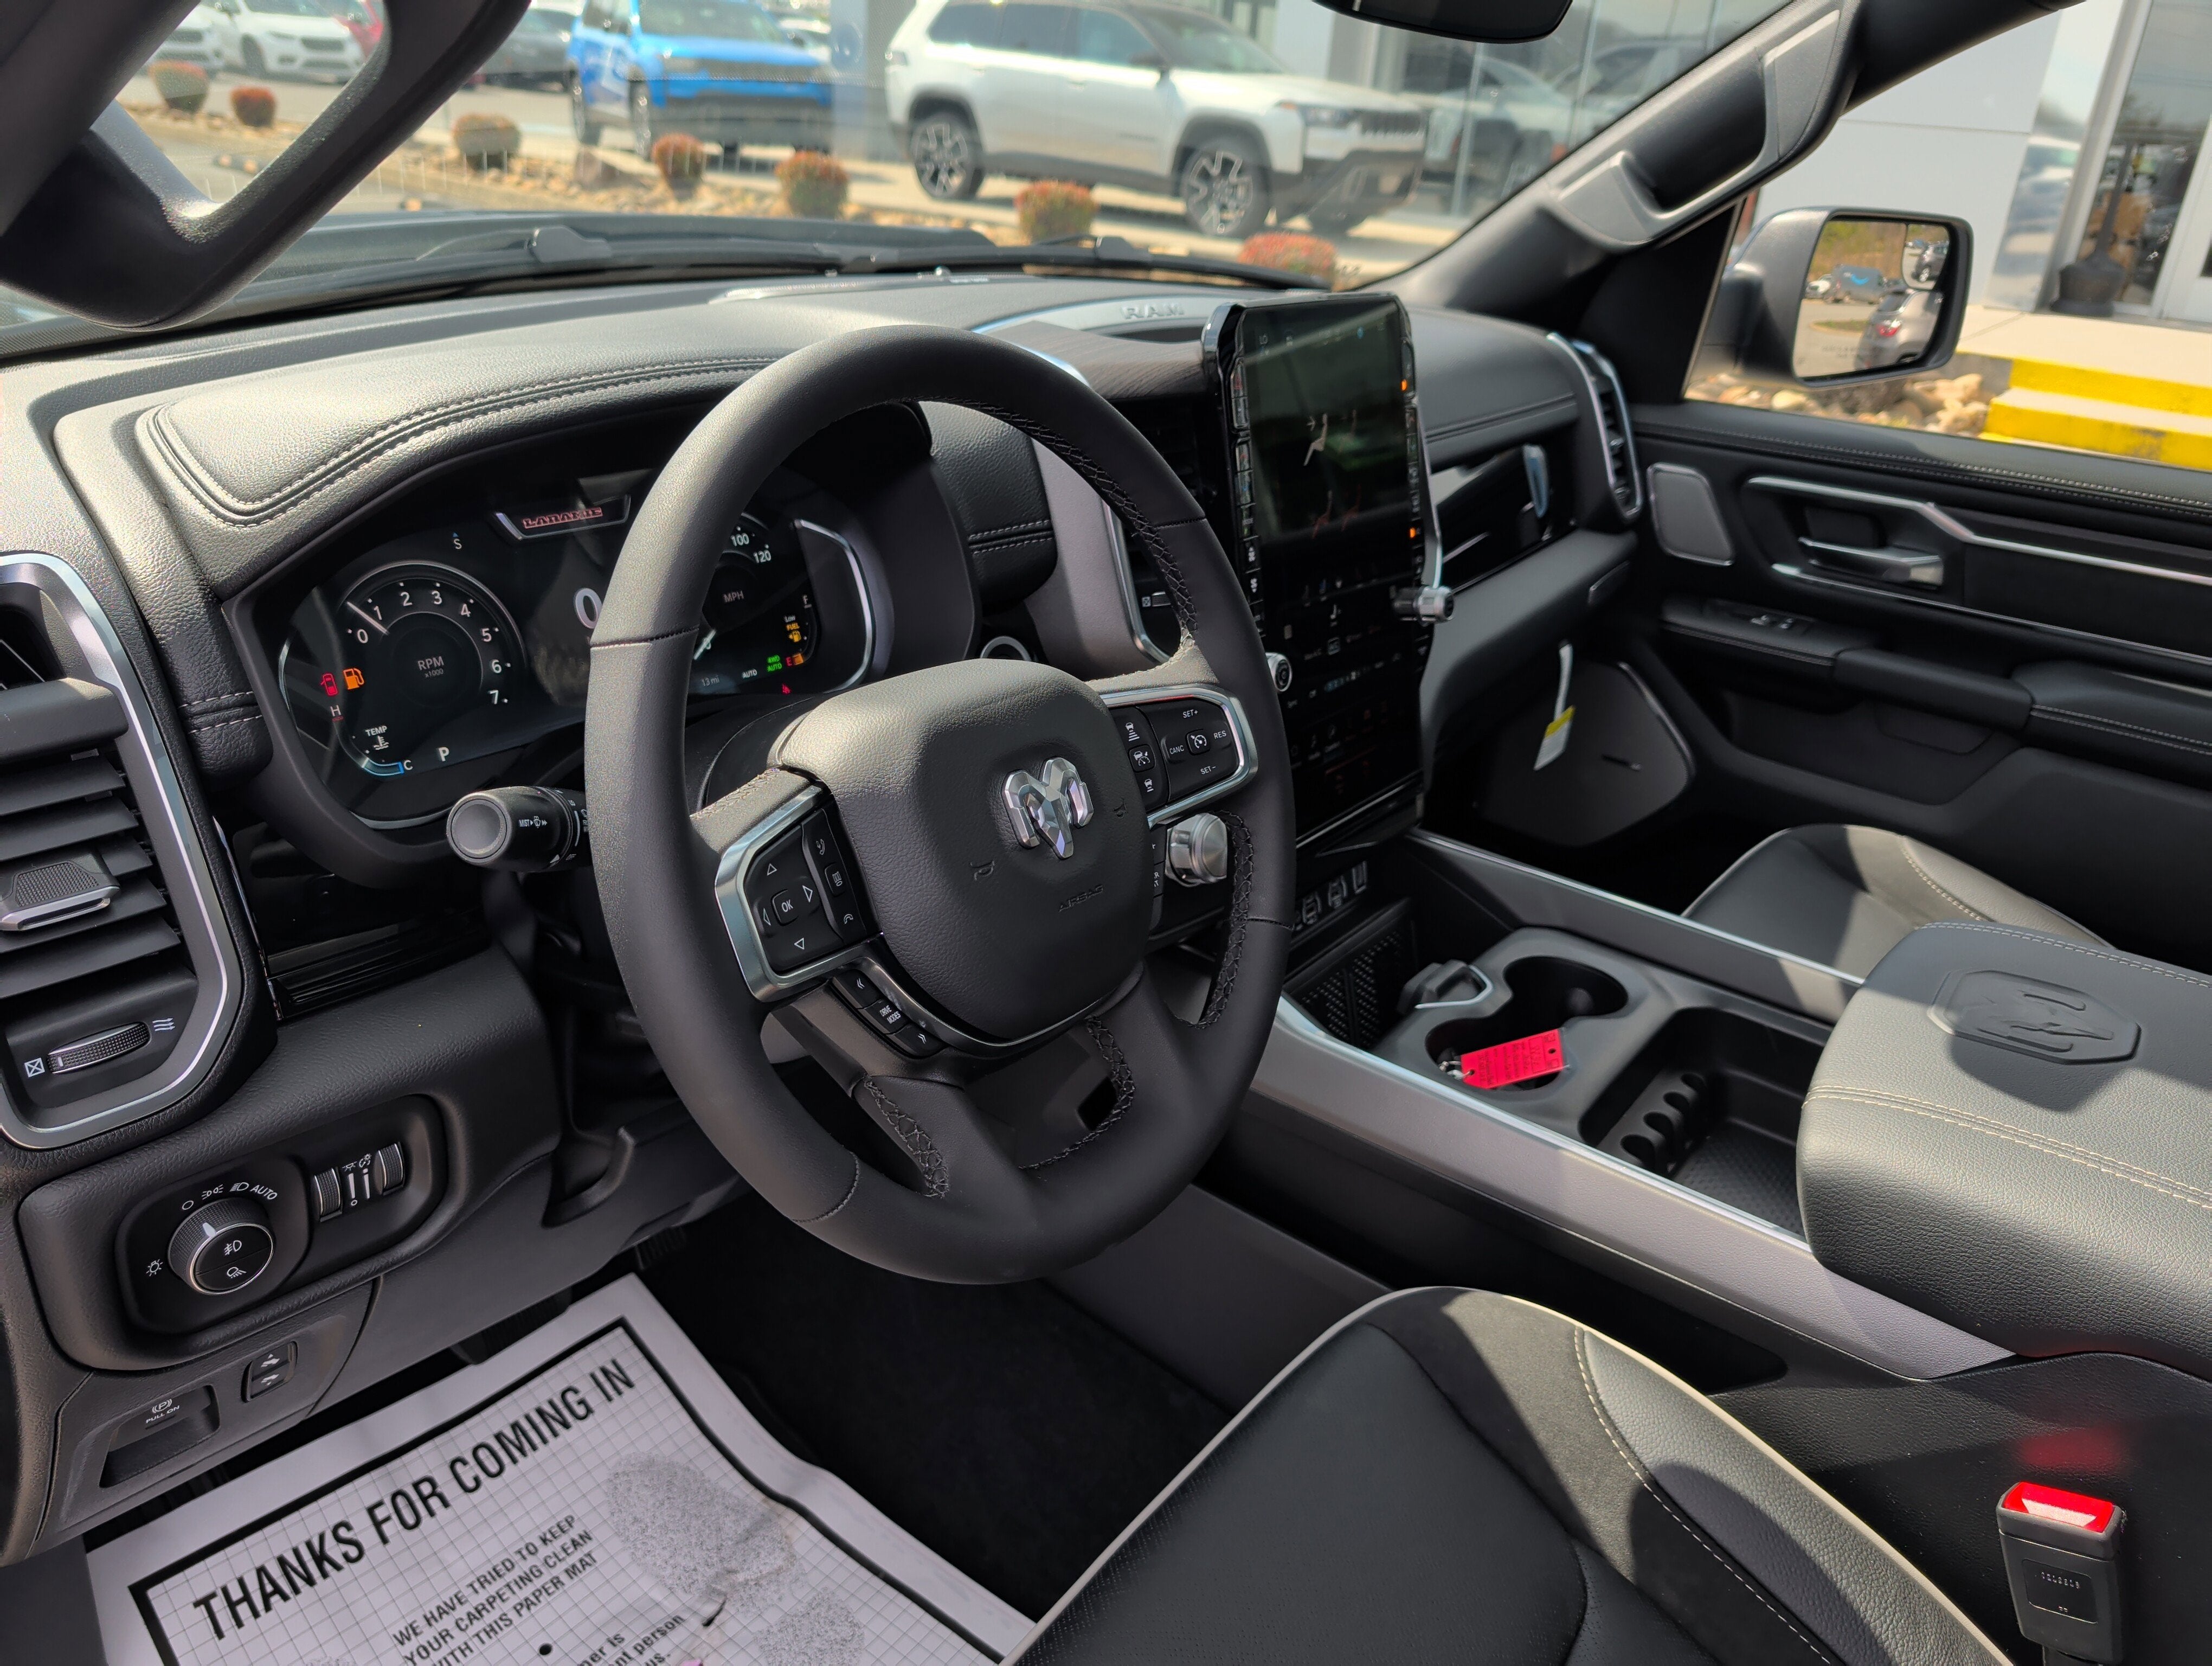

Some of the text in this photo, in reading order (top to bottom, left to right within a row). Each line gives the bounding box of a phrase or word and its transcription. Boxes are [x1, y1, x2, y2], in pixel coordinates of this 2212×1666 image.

[1120, 303, 1184, 319] RAM
[522, 507, 603, 529] LARAMIE
[453, 539, 462, 550] S
[731, 534, 749, 546] 100
[754, 550, 771, 563] 120
[401, 592, 413, 606] 2
[432, 590, 443, 604] 3
[723, 591, 744, 603] MPH
[460, 603, 471, 617] 4
[356, 629, 369, 644] 0
[481, 628, 492, 642] 5
[417, 656, 445, 671] RPM
[491, 659, 502, 673] 6
[742, 668, 757, 679] AUTO
[489, 690, 499, 704] 7
[330, 705, 341, 717] H
[365, 725, 387, 737] TEMP
[1213, 731, 1227, 739] RES
[438, 747, 450, 761] P
[1169, 745, 1184, 754] CANC
[404, 760, 413, 771] C
[519, 819, 530, 827] MIST
[781, 899, 793, 913] OK
[879, 1005, 892, 1017] DRIVE
[887, 1011, 901, 1024] MODES
[250, 1185, 278, 1200] AUTO
[146, 1405, 180, 1424] PULL ON
[192, 1357, 636, 1642] THANKS FOR COMING IN
[392, 1514, 576, 1648] WE HAVE TRIED TO KEEP
[403, 1529, 594, 1666] YOUR CARPETING CLEAN
[471, 1612, 515, 1649] THIS
[513, 1576, 566, 1617] PAPER
[564, 1552, 599, 1582] MAT
[606, 1633, 626, 1649] is
[633, 1613, 685, 1656] person
